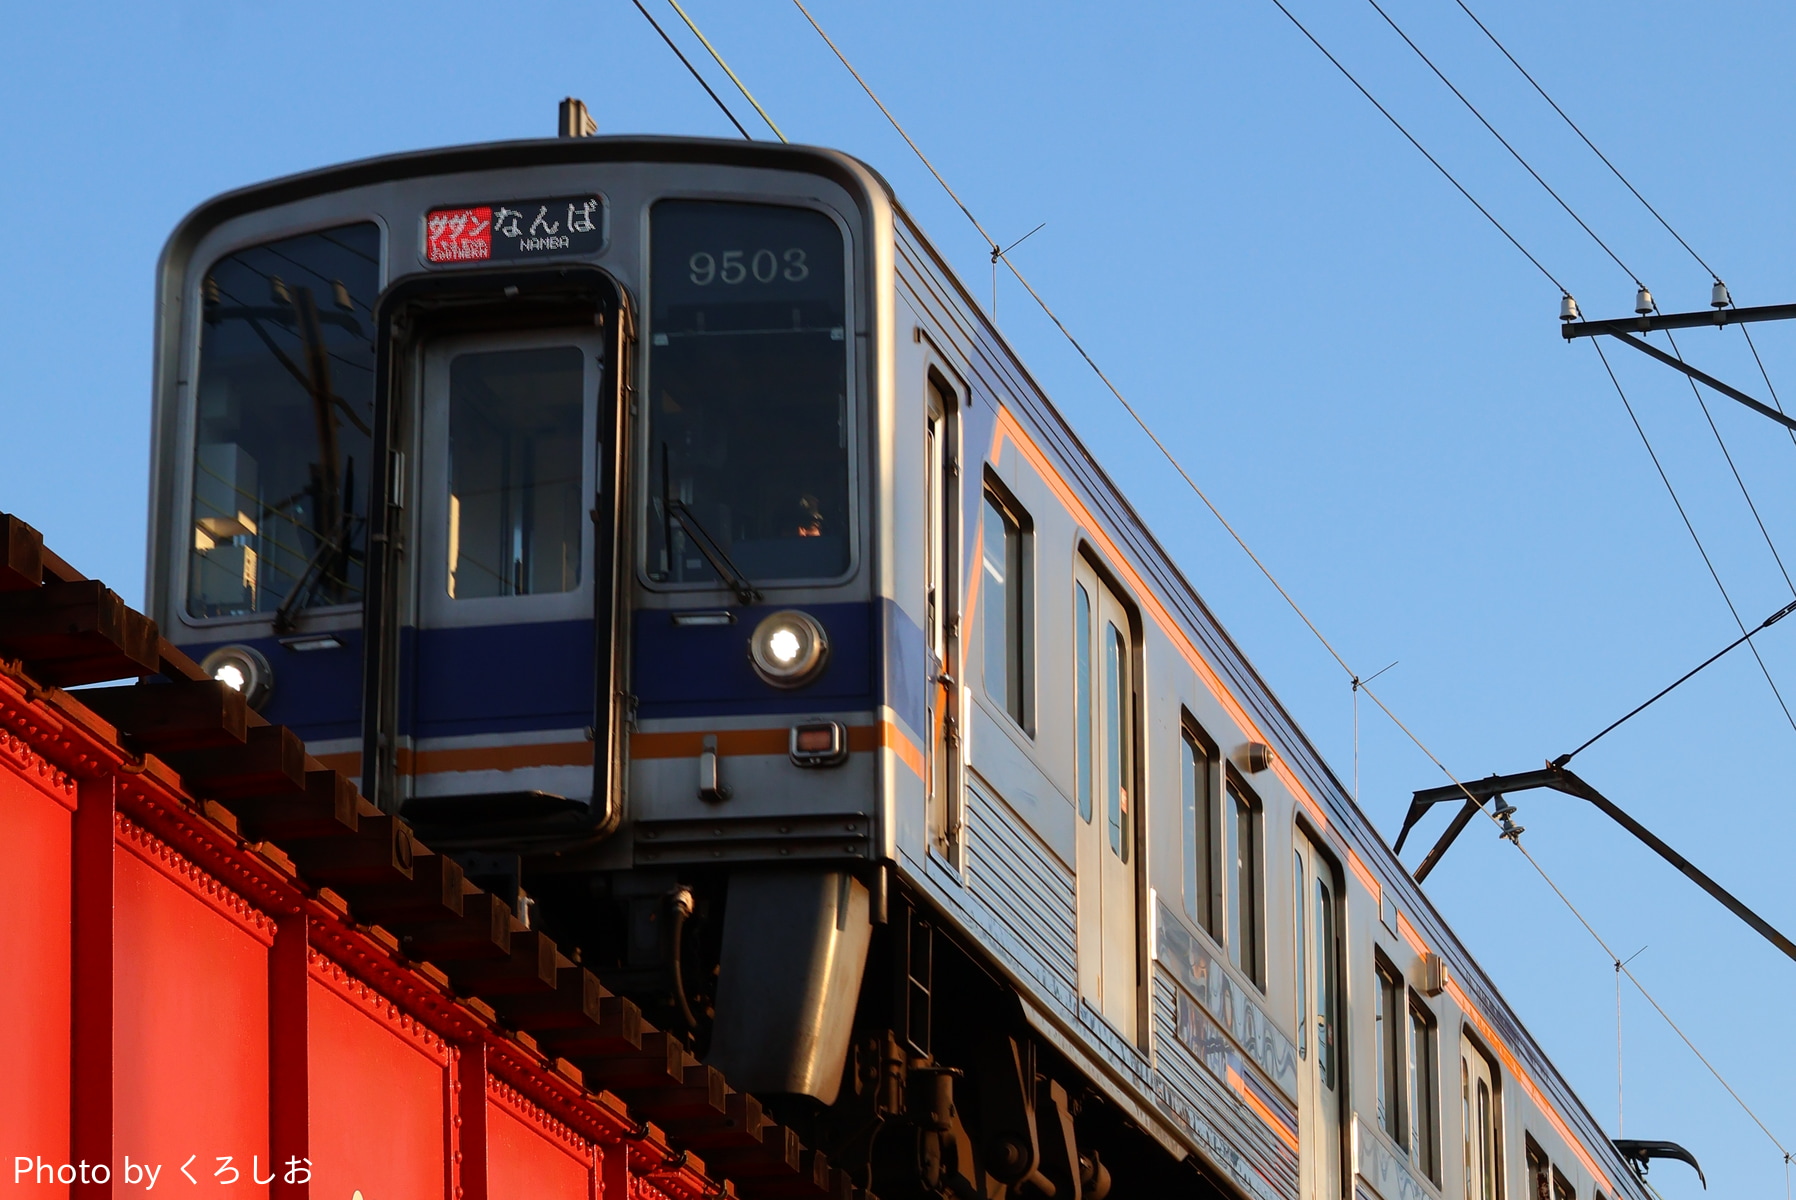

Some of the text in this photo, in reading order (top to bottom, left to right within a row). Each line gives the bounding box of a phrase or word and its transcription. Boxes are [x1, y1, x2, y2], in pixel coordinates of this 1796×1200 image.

[427, 210, 490, 240] サザン
[494, 198, 598, 237] なんば
[519, 235, 570, 252] NAMBA
[689, 248, 809, 285] 9503
